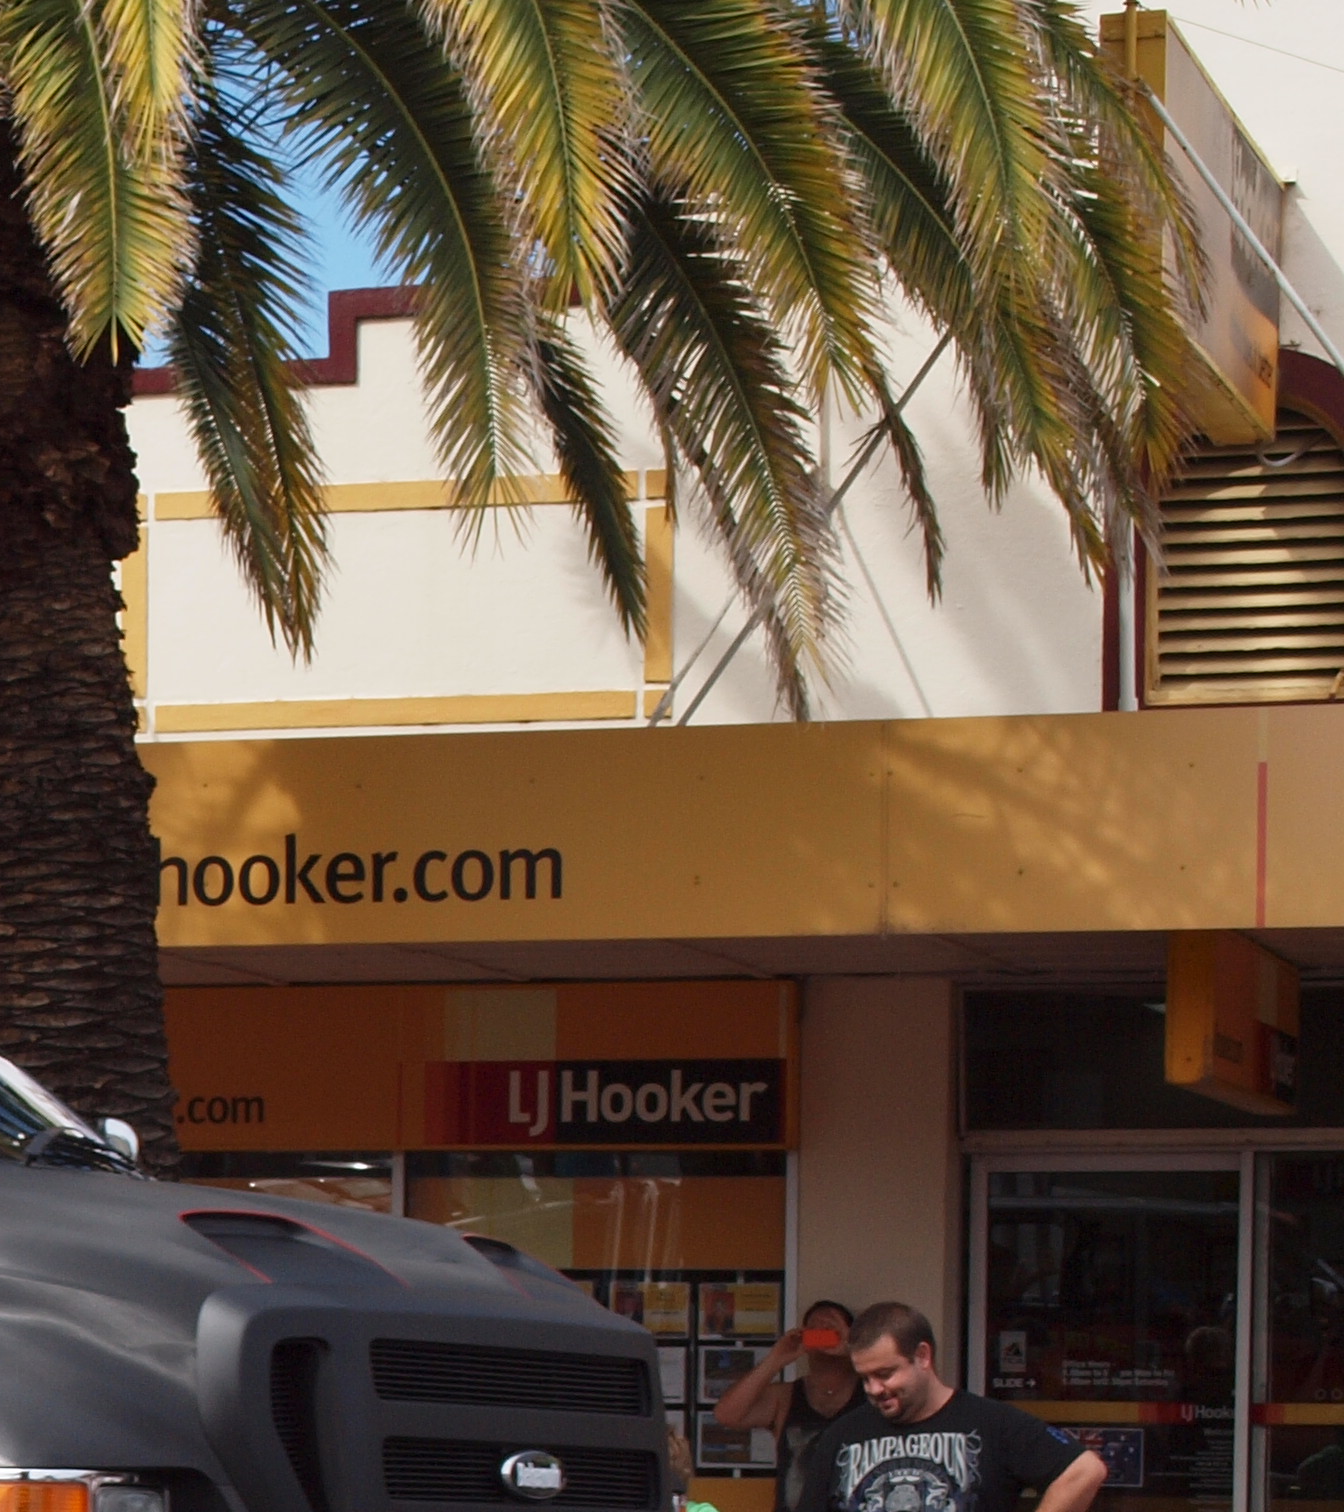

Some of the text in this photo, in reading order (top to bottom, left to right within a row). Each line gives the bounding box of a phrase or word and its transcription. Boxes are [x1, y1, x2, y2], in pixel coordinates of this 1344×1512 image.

[508, 1069, 768, 1137] LJ Hooker
[846, 1432, 970, 1498] RAMPAGEOUS
